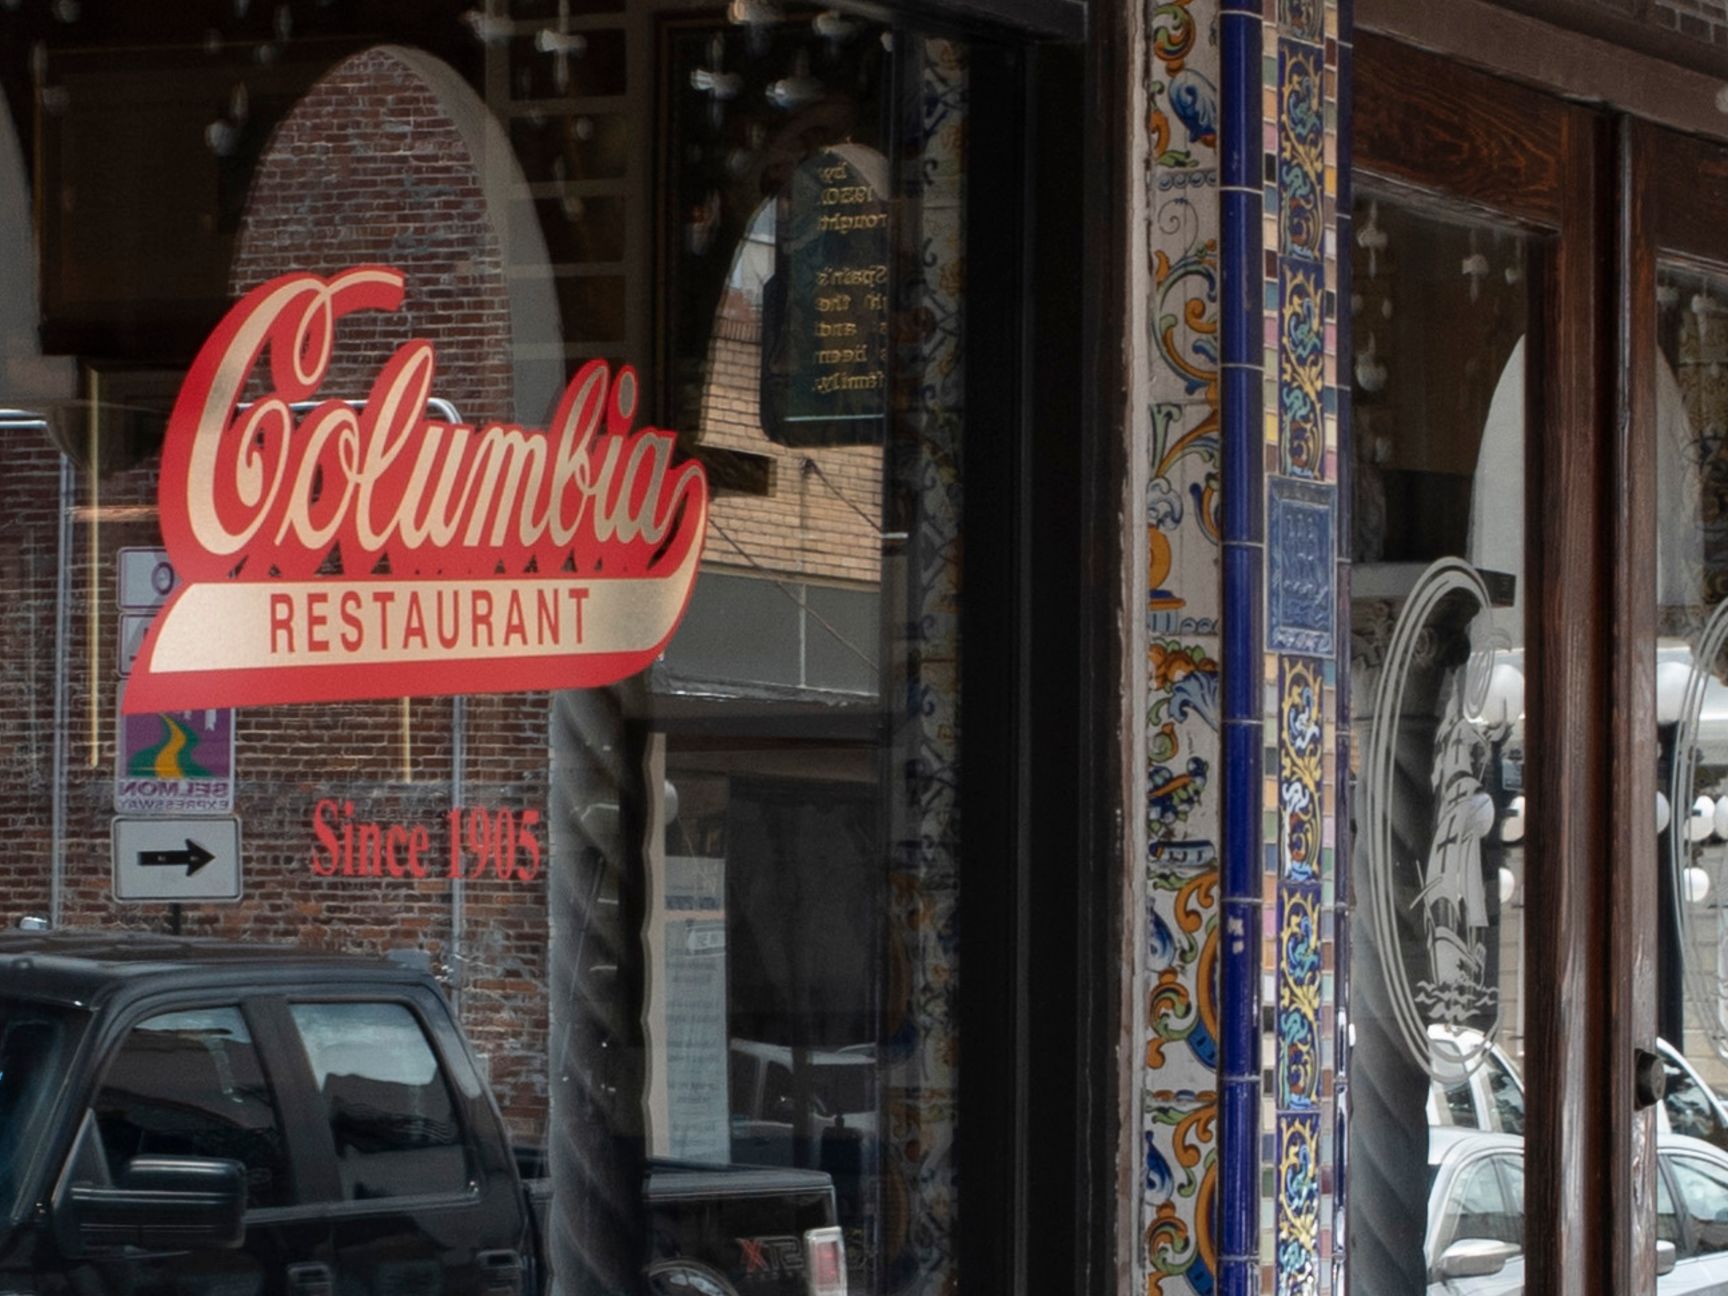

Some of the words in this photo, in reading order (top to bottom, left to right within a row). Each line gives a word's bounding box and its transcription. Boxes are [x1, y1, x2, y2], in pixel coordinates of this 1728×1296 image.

[184, 268, 699, 558] Columbia
[269, 588, 590, 654] RESTAURANT
[311, 798, 430, 878] Since
[446, 804, 542, 882] 1905
